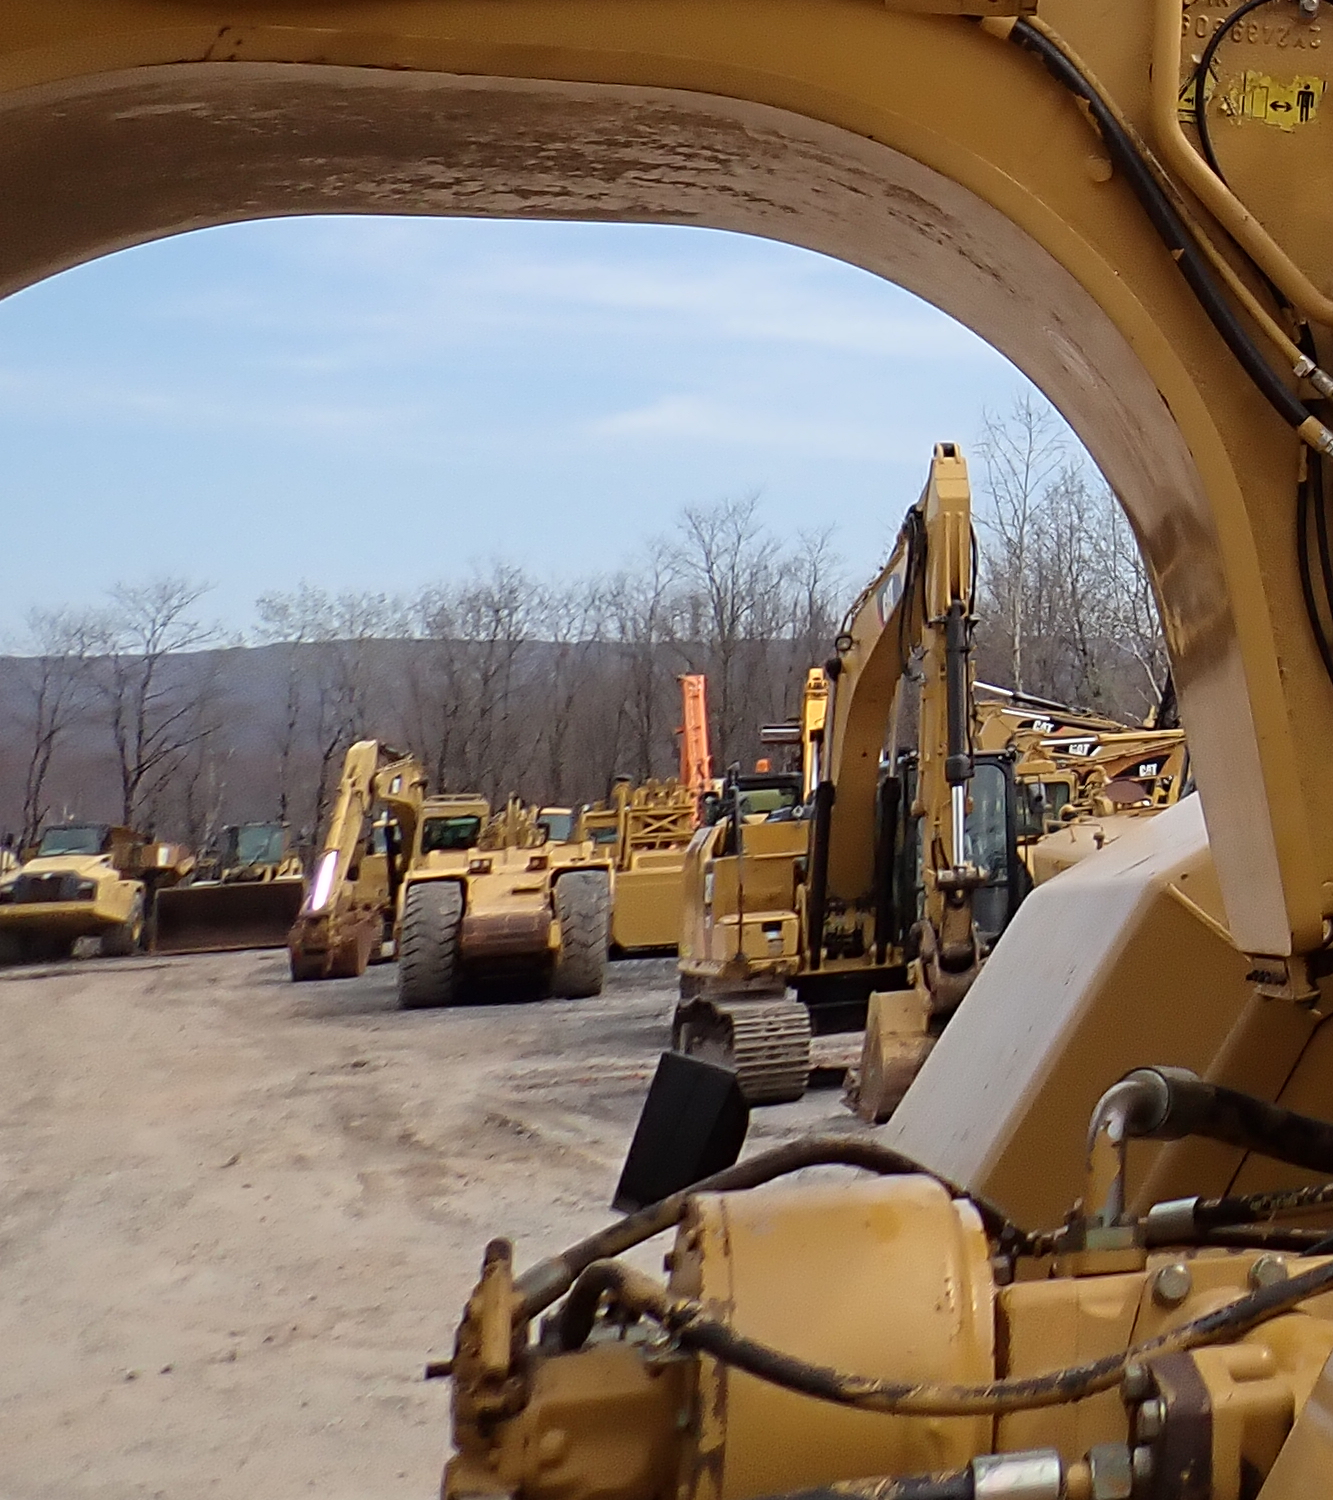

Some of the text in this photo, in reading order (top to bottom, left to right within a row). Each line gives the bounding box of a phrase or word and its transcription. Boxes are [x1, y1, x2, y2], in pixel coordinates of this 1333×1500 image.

[1032, 720, 1054, 733] CAT
[1069, 743, 1091, 756] CAT
[1139, 763, 1158, 777] CAT
